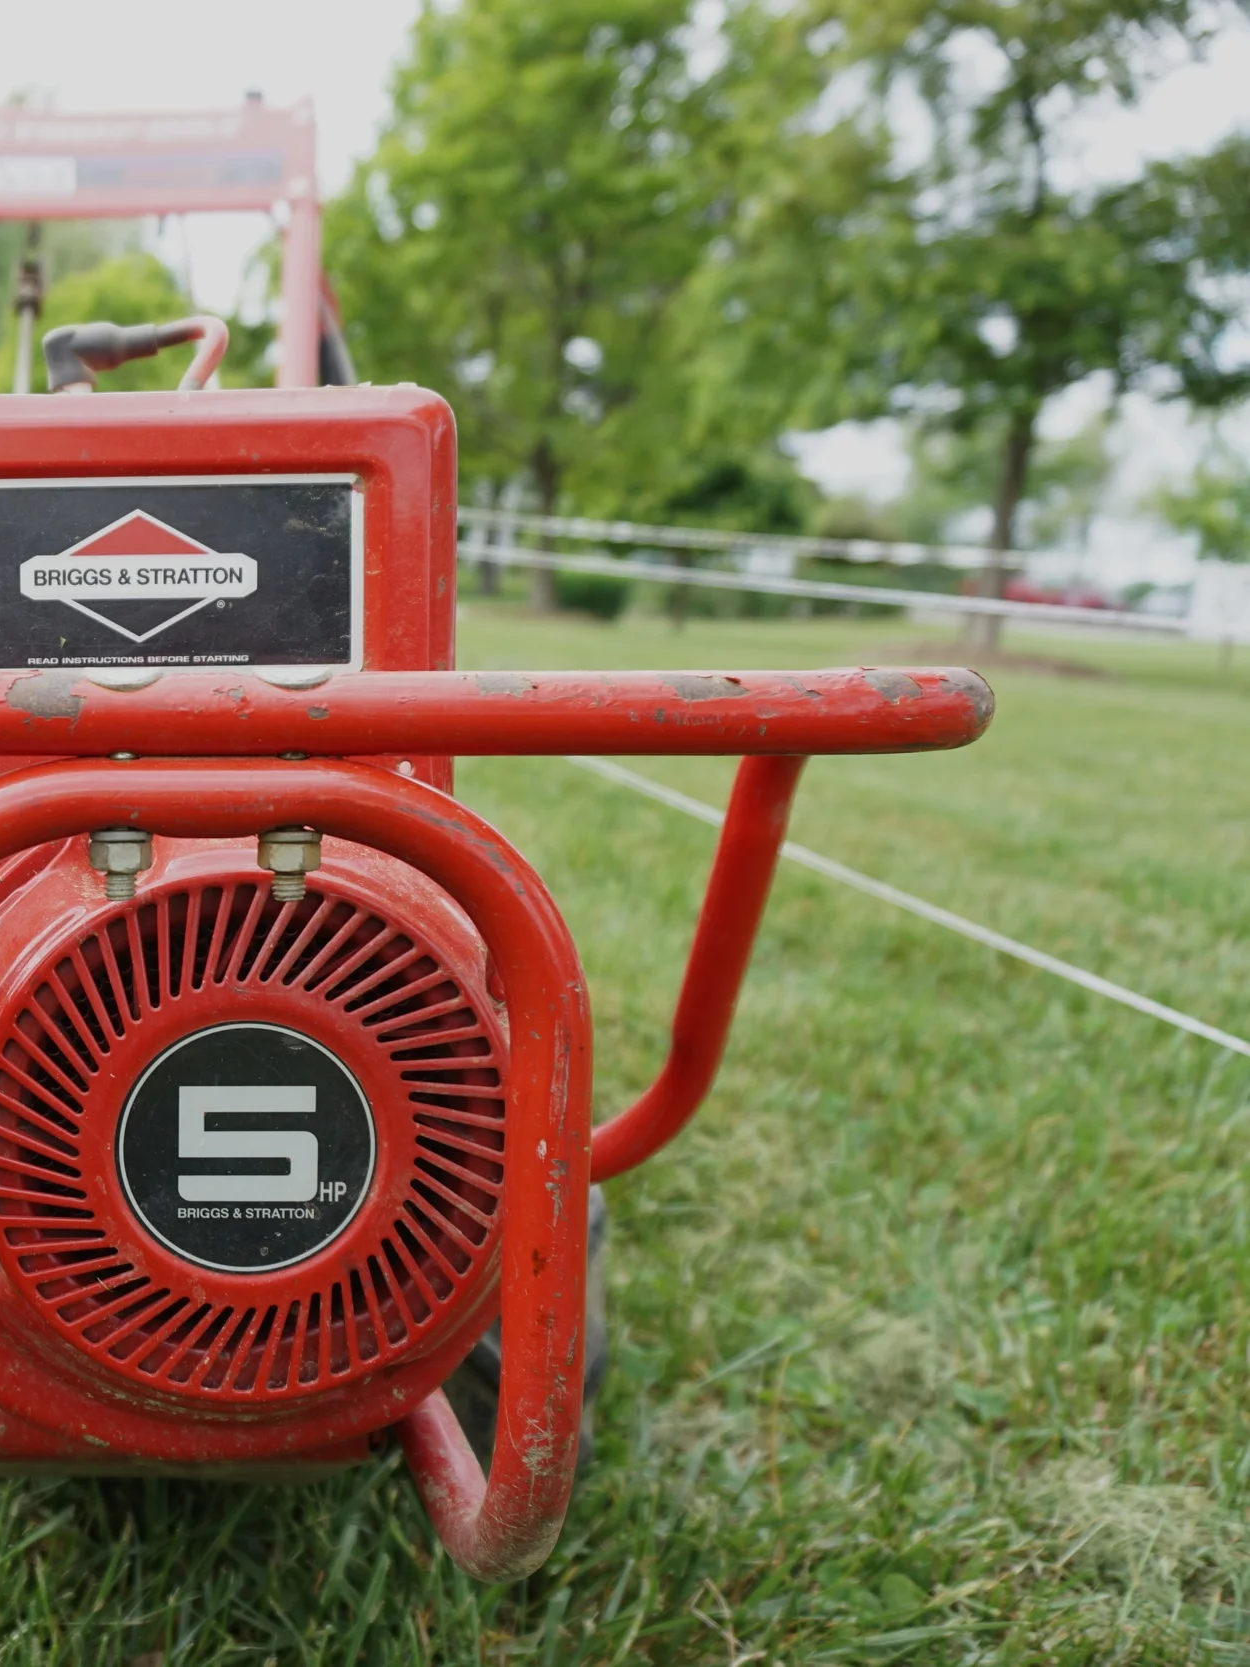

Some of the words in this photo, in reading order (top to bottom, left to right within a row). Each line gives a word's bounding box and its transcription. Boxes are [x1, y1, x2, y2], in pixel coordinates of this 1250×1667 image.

[33, 568, 112, 587] BRIGGS
[117, 568, 132, 585] &
[136, 566, 244, 585] STRATTON
[27, 656, 59, 665] READ
[62, 655, 145, 665] INSTRUCTIONS
[147, 655, 190, 664] BEFORE
[193, 653, 250, 663] STARTING
[177, 1085, 319, 1202] 5
[319, 1181, 347, 1202] HP
[177, 1207, 229, 1219] BRIGGS
[233, 1207, 243, 1219] &
[245, 1207, 315, 1219] STRATTON
